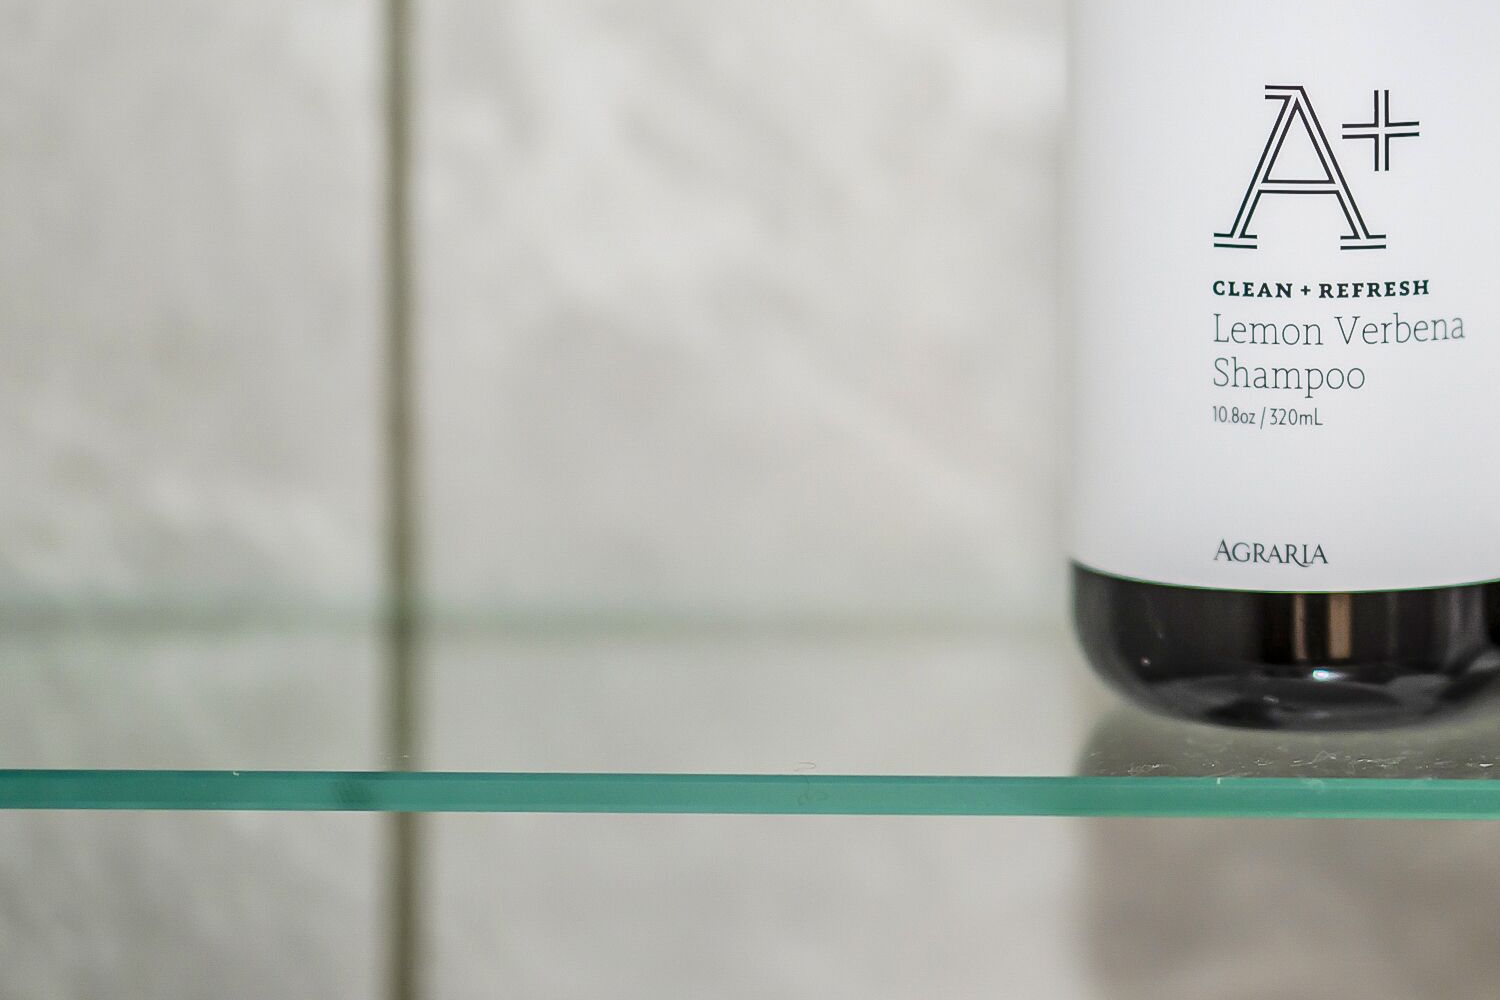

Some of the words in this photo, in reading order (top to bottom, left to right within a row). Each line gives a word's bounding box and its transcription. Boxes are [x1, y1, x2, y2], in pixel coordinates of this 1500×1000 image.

[1213, 280, 1293, 298] CLEAN
[1300, 285, 1311, 296] +
[1319, 279, 1429, 298] REFRESH
[1213, 313, 1324, 345] Lemon
[1334, 312, 1465, 344] Verbena
[1213, 356, 1365, 398] Shampoo
[1213, 539, 1328, 568] AGRARIA
